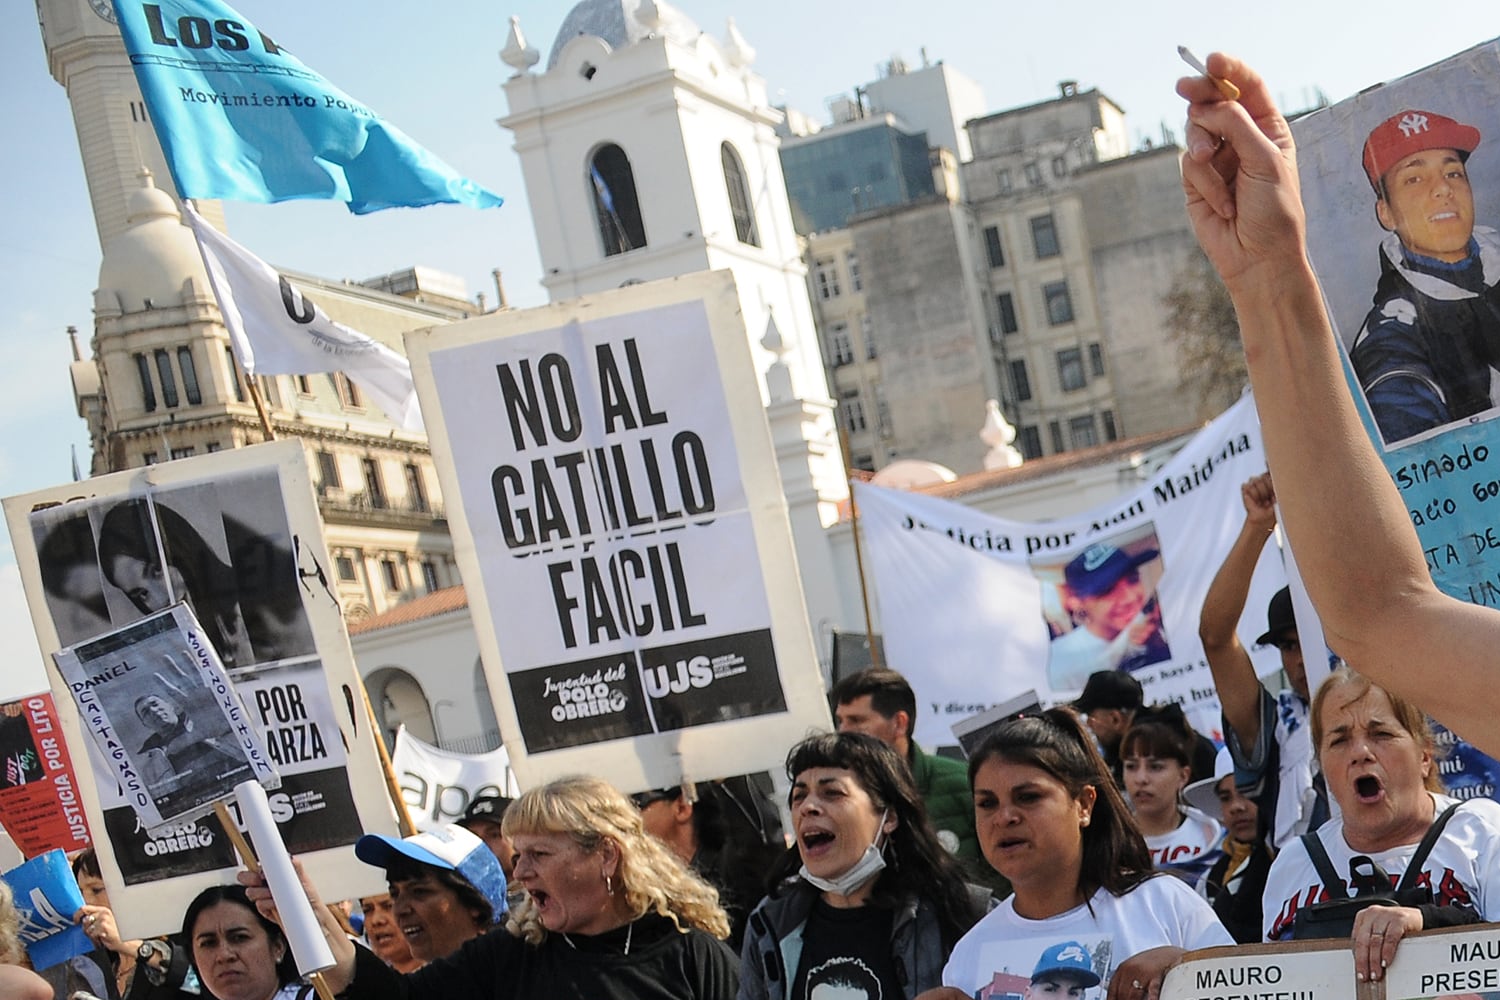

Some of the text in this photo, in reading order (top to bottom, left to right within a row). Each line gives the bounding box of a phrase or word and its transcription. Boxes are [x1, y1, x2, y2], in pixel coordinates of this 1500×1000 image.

[143, 4, 250, 52] LOS
[178, 87, 317, 109] Movimiento
[496, 337, 669, 451] NO AL
[1393, 443, 1489, 490] sinado
[490, 430, 717, 556] GATILLO
[1408, 497, 1458, 527] acio
[1024, 530, 1078, 557] por
[543, 662, 626, 698] Juventud del
[558, 682, 610, 705] POLO
[645, 655, 714, 699] UJS
[254, 683, 308, 727] POR
[28, 697, 91, 844] JUSTICIA POR LITO
[1196, 964, 1284, 990] MAURO
